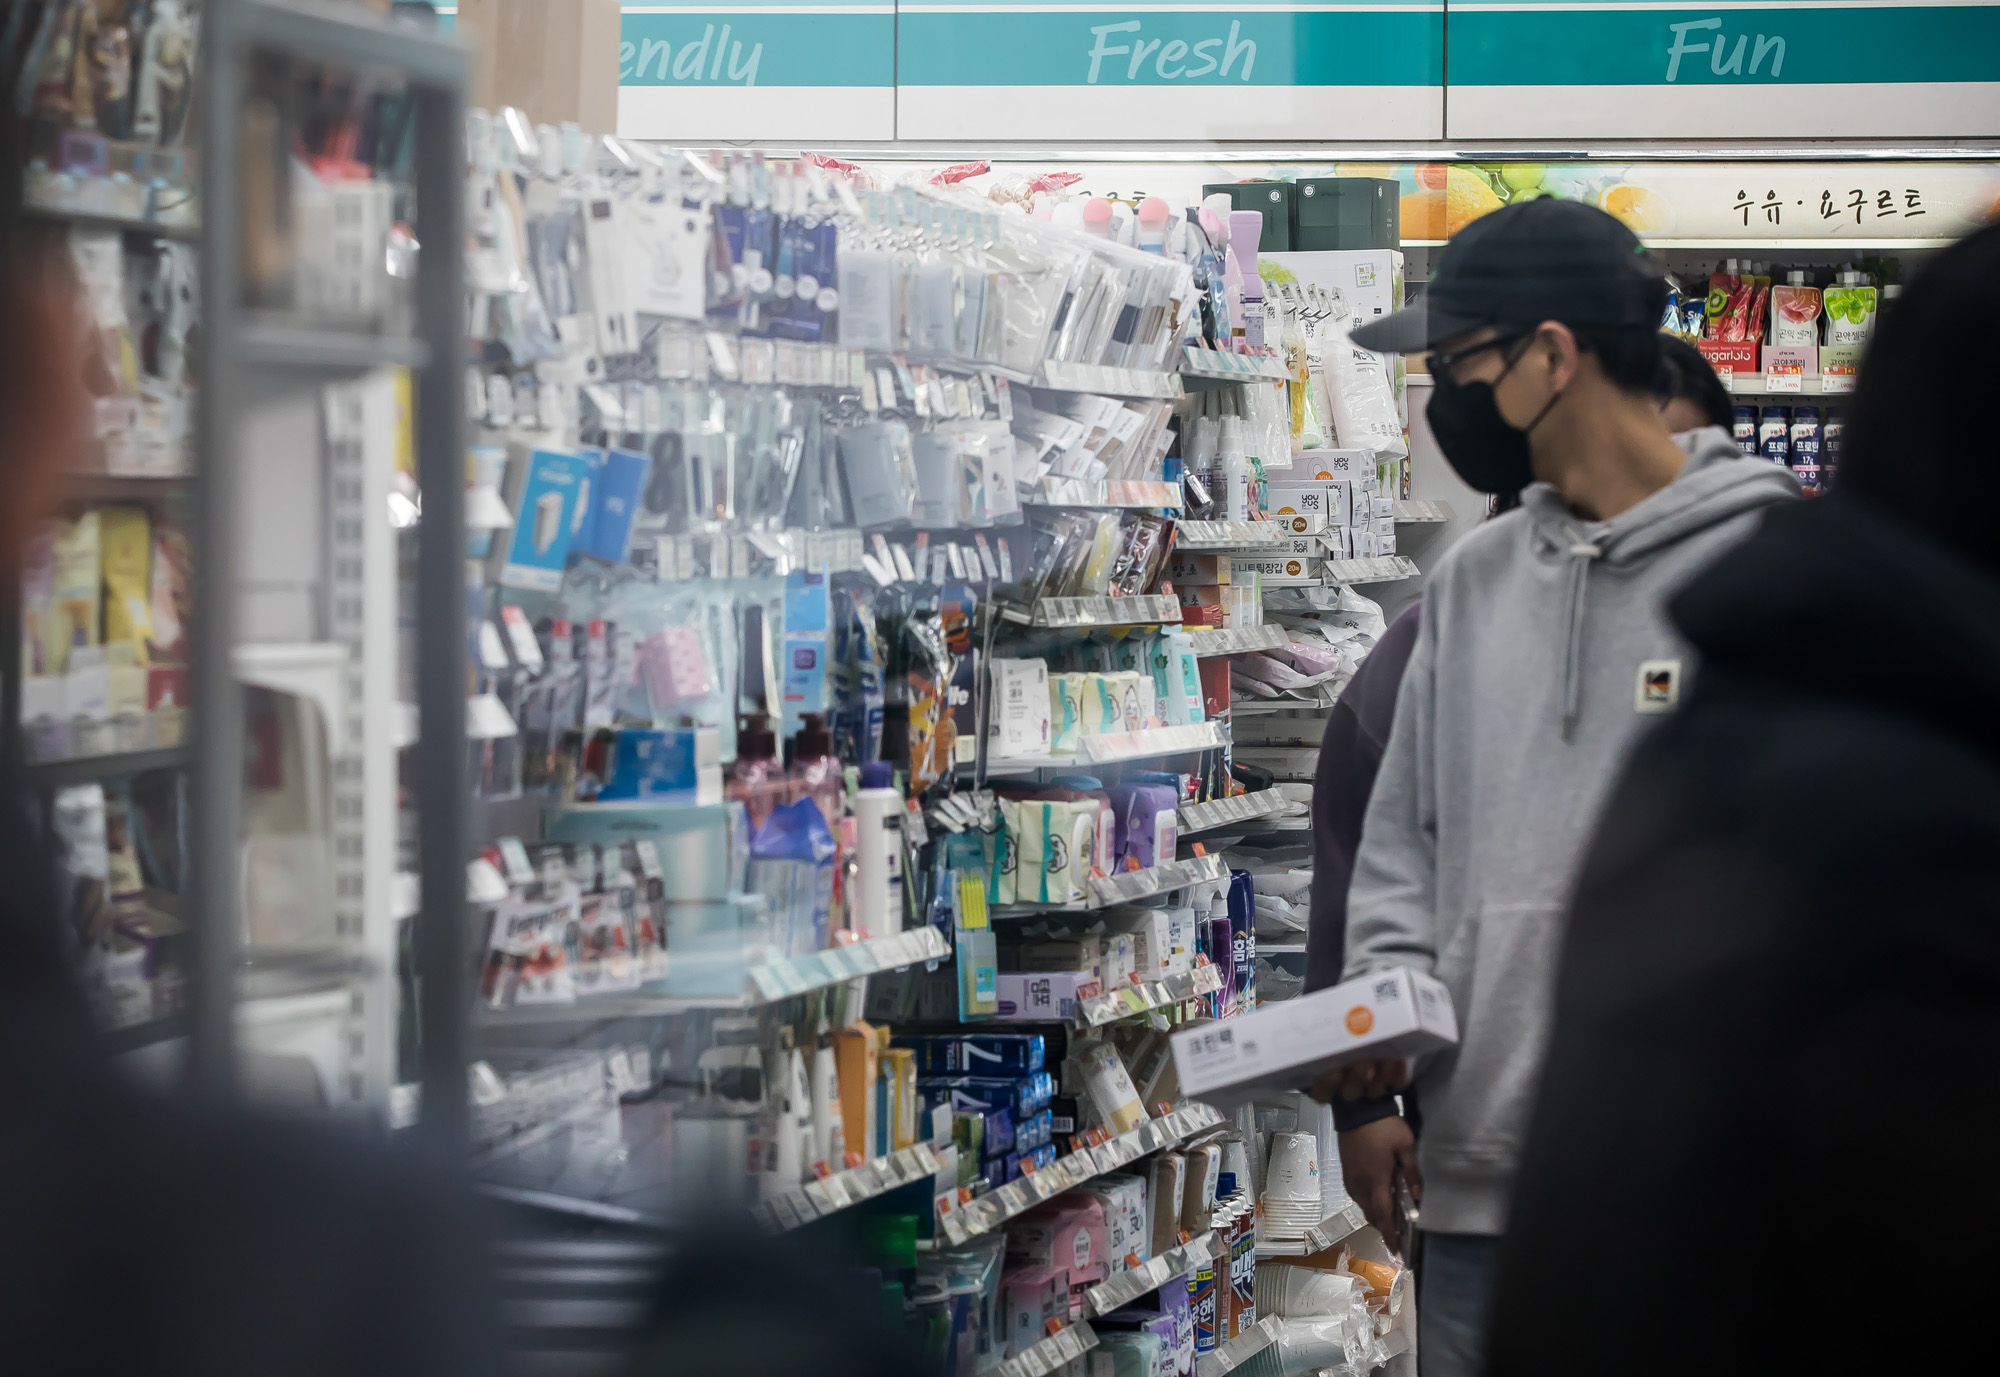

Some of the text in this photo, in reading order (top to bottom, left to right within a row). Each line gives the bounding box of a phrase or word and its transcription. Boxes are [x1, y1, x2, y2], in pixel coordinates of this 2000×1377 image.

[1086, 20, 1257, 84] Fresh
[1665, 17, 1786, 82] Fun
[1788, 366, 1801, 374] 1+1
[1843, 367, 1856, 375] 1+1
[1797, 441, 1819, 453] 프로틴
[1333, 457, 1349, 467] you
[1802, 456, 1814, 466] 17g
[1301, 494, 1319, 506] you
[1238, 563, 1283, 575] 니트릴장갑
[962, 1042, 1003, 1071] 7
